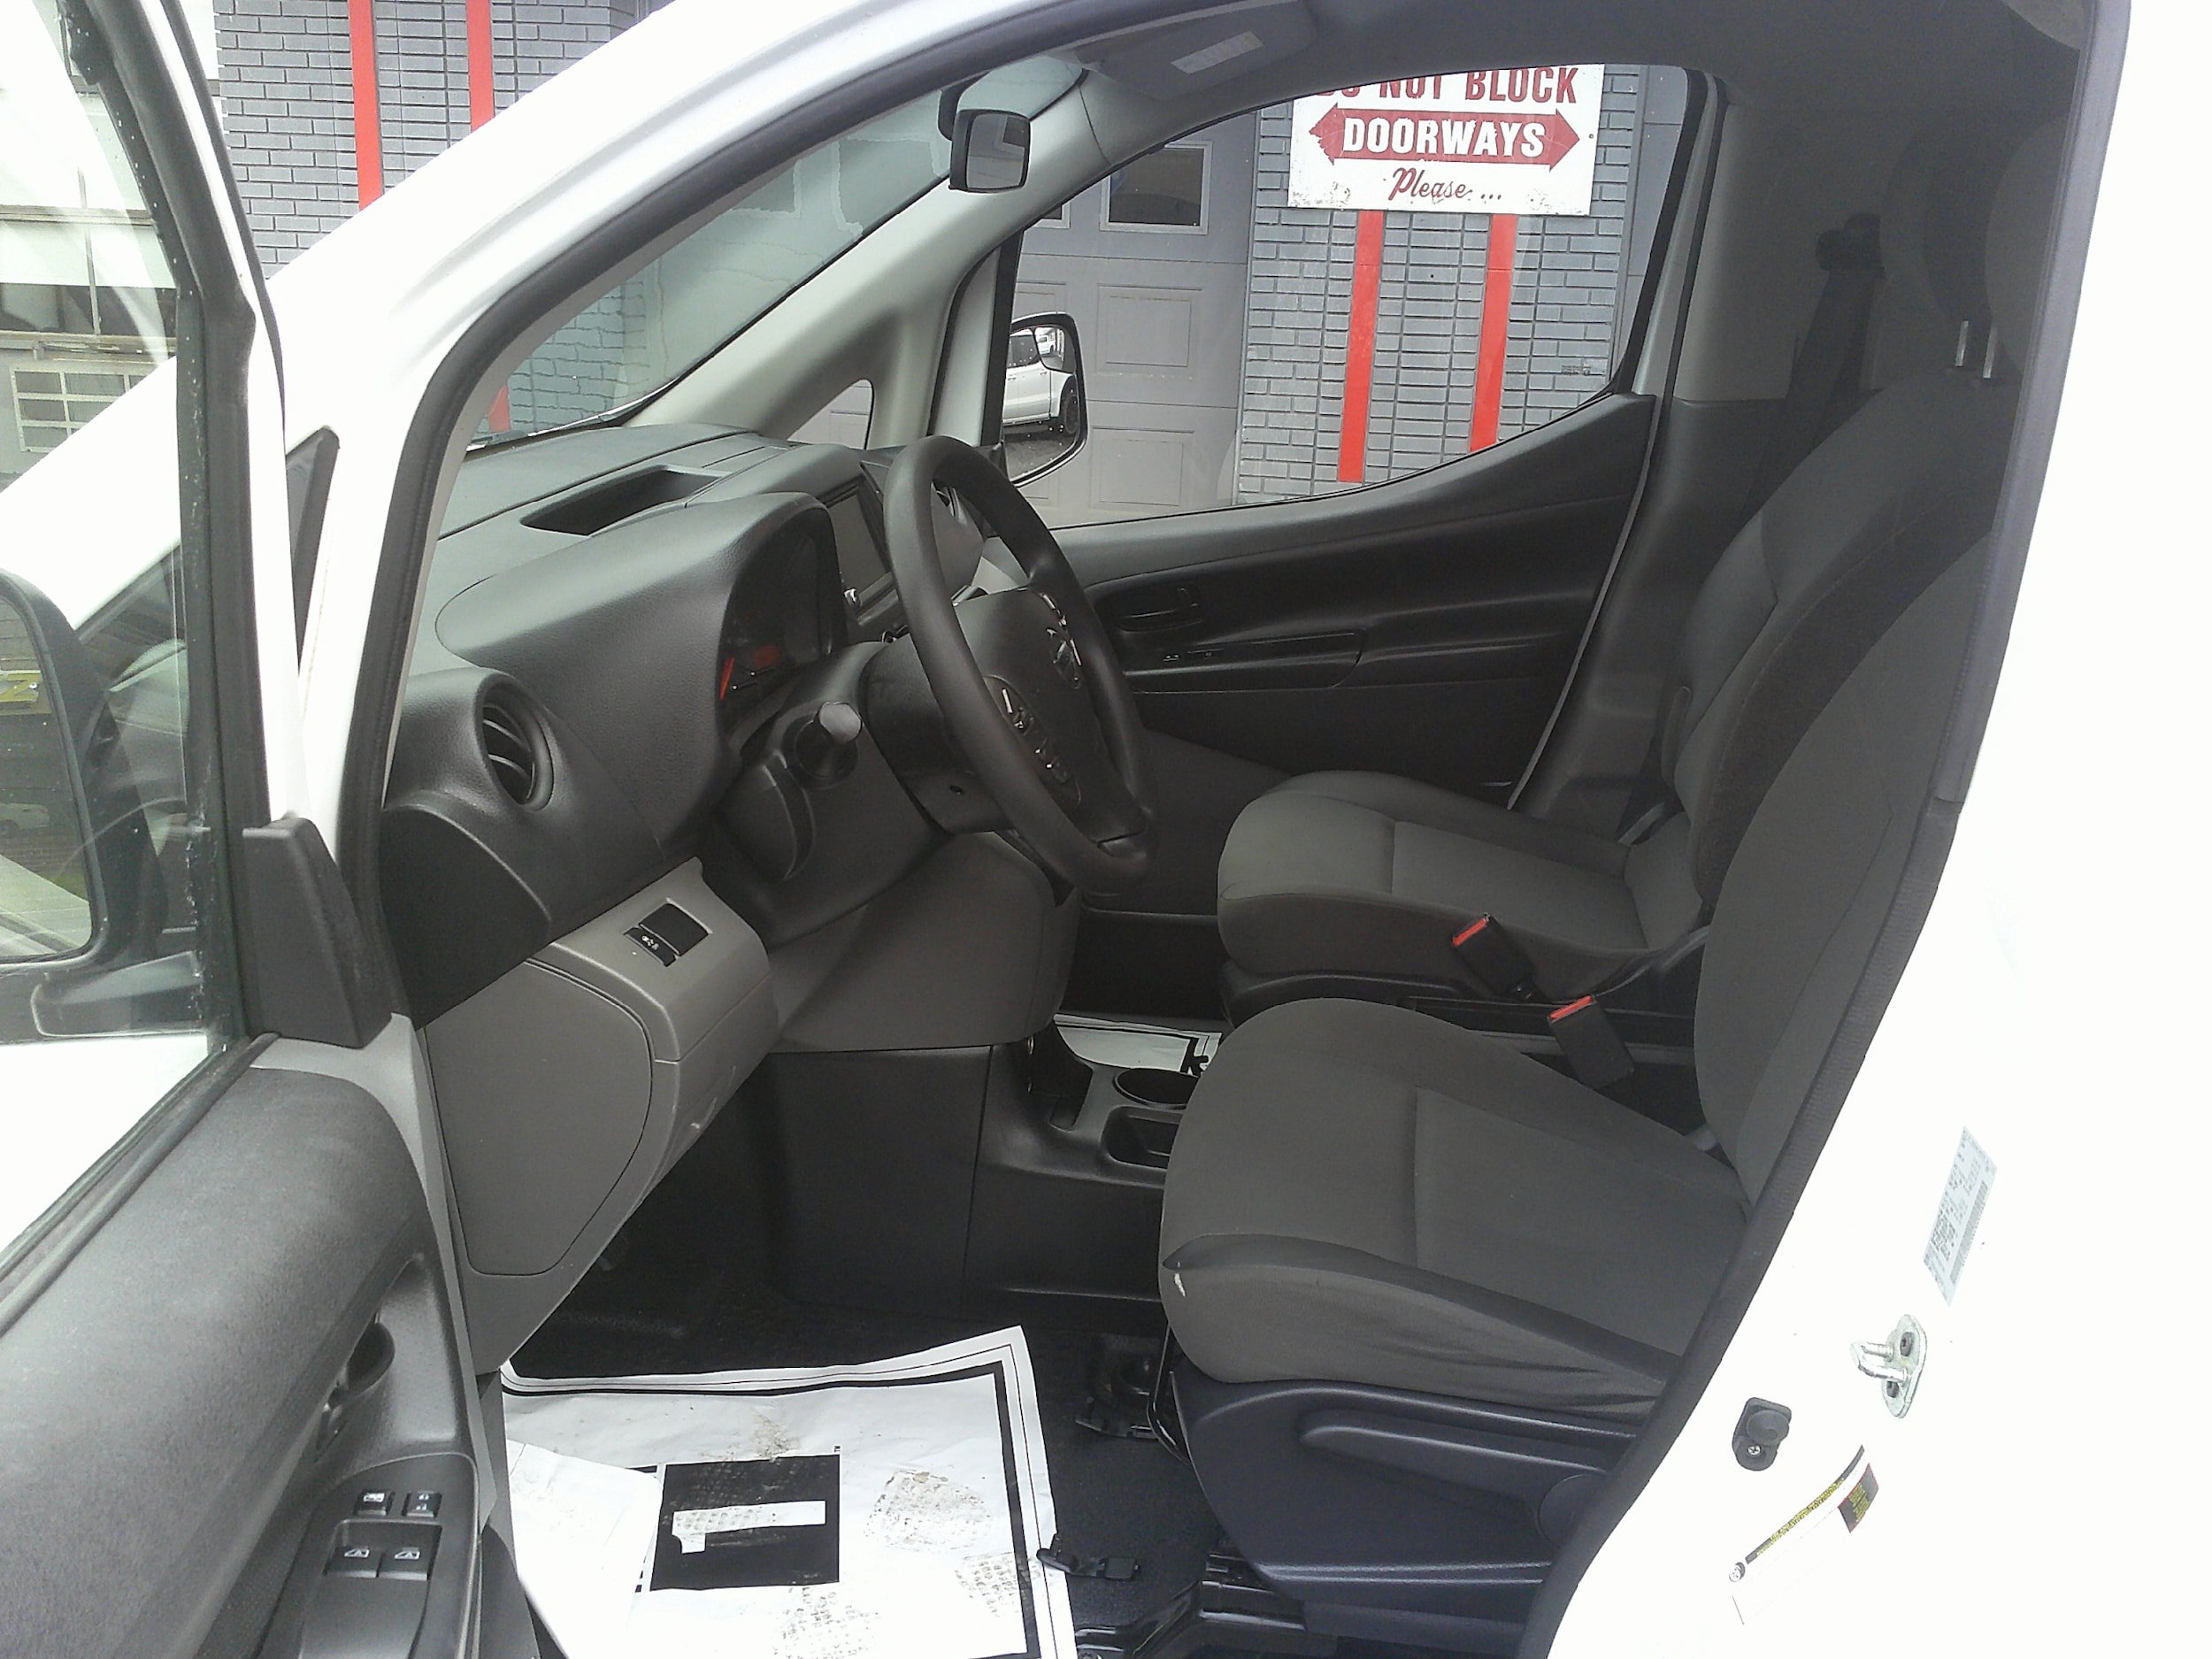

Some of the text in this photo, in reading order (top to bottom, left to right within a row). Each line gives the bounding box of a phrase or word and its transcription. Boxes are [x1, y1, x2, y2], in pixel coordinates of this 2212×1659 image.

[1465, 68, 1578, 103] BLOCK
[1343, 117, 1545, 157] DOORWAYS
[1388, 167, 1472, 201] Please
